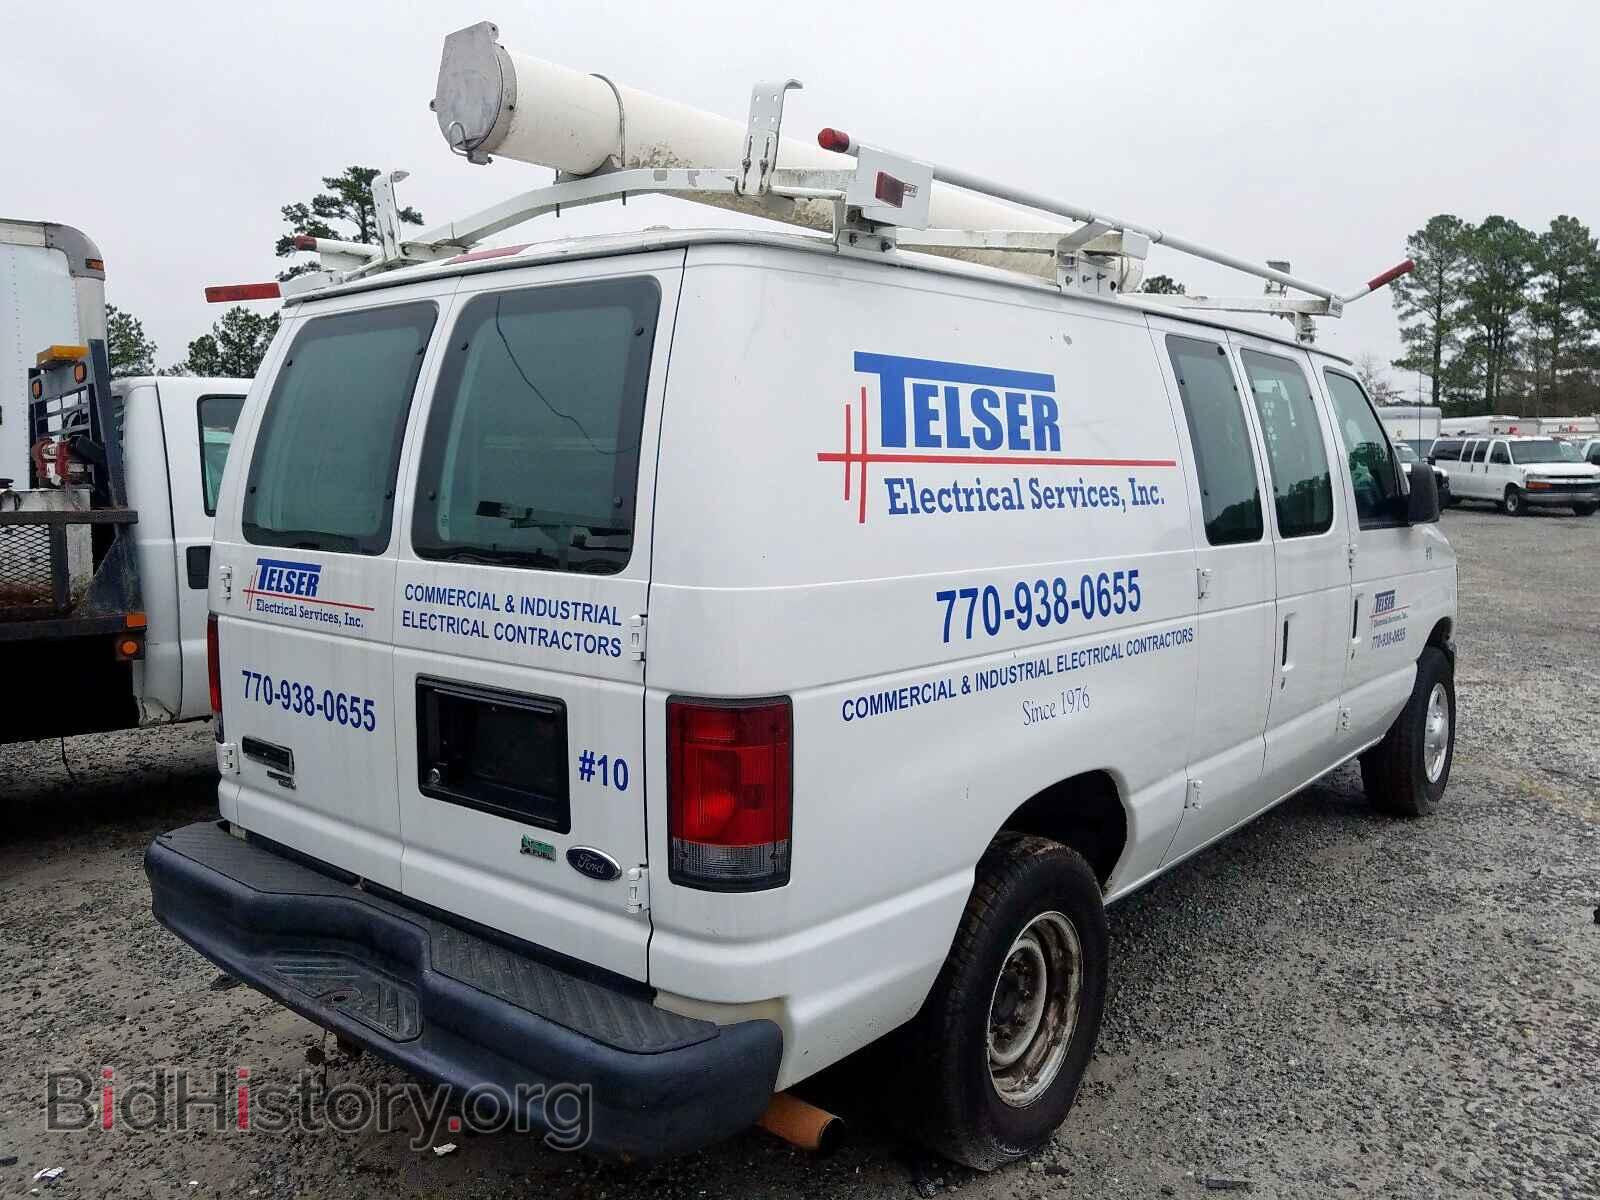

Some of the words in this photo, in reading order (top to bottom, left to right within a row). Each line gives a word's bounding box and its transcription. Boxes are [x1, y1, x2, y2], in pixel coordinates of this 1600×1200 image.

[854, 351, 1061, 452] TELSER
[884, 477, 1024, 515] Electrical
[1030, 477, 1127, 513] Services,
[1129, 477, 1165, 506] Inc.
[257, 558, 322, 597] TELSER
[256, 599, 297, 617] Electrical
[299, 606, 342, 627] Services,
[344, 612, 364, 628] Inc.
[404, 583, 500, 612] COMMERCIAL
[504, 594, 515, 613] &
[520, 596, 622, 626] INDUSTRIAL
[936, 569, 1141, 644] 770-938-0655
[402, 610, 489, 639] ELECTRICAL
[494, 622, 622, 658] CONTRACTORS
[842, 679, 956, 722] COMMERCIAL
[960, 675, 972, 695] &
[975, 658, 1053, 692] INDUSTRIAL
[1057, 642, 1124, 673] ELECTRICAL
[1127, 627, 1194, 657] CONTRACTORS
[242, 670, 377, 732] 770-938-0655
[1022, 700, 1056, 727] Since
[1061, 684, 1091, 715] 1976
[578, 749, 630, 791] #10
[577, 853, 606, 873] Ford
